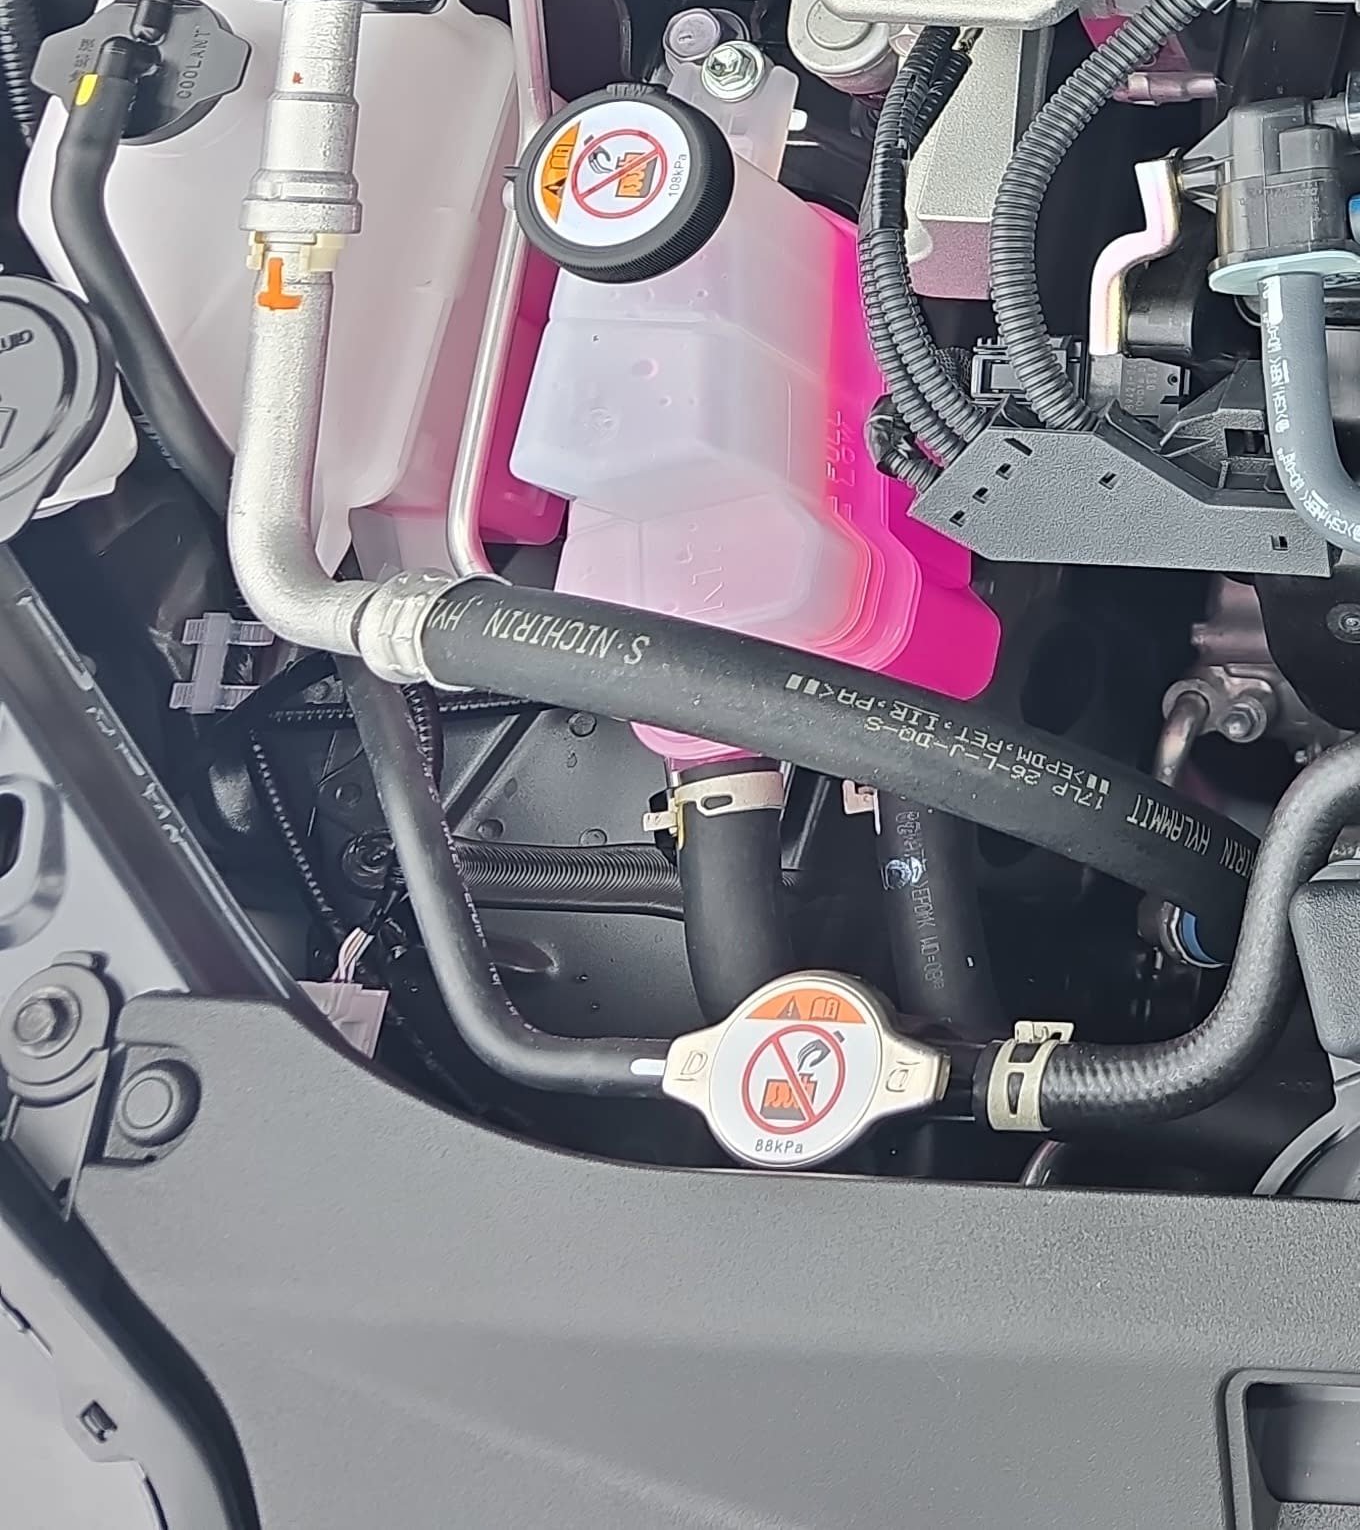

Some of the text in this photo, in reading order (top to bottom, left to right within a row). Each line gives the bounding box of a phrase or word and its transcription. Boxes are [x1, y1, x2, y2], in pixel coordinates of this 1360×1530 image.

[177, 27, 211, 100] COOLANT
[667, 152, 688, 198] 108kPa
[1125, 791, 1214, 858] HYLAMMIT
[754, 1136, 804, 1156] 88kPa
